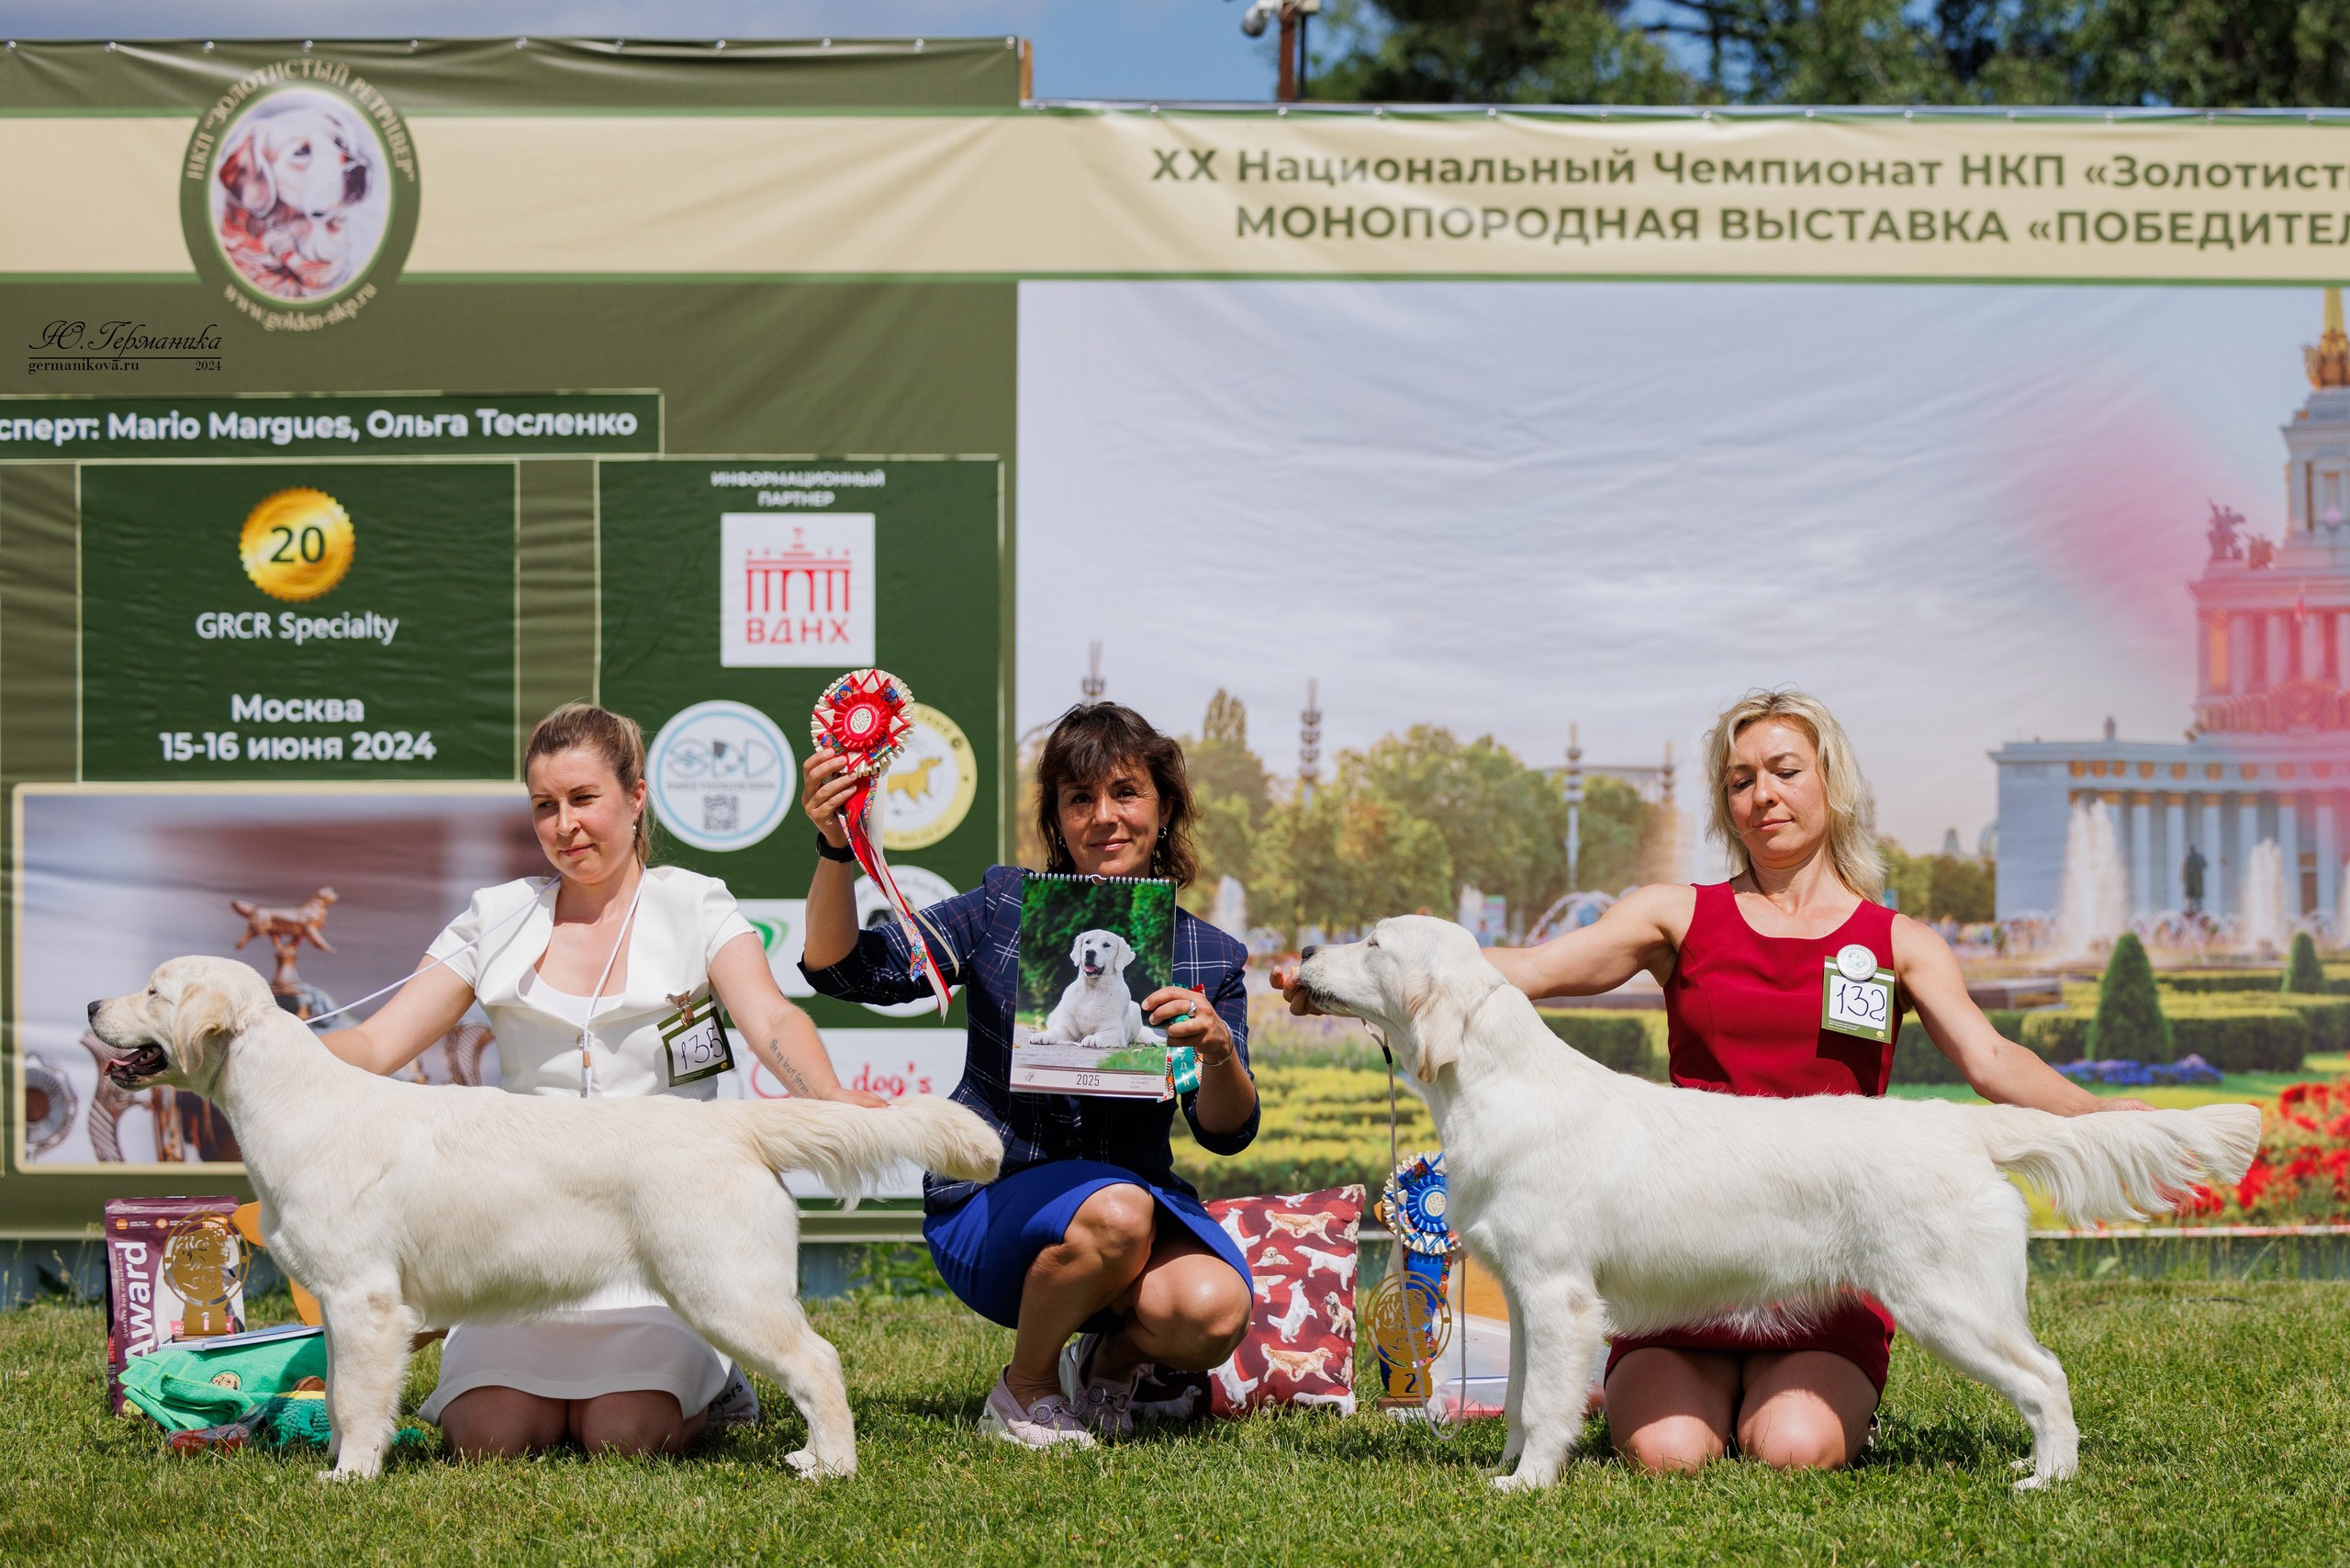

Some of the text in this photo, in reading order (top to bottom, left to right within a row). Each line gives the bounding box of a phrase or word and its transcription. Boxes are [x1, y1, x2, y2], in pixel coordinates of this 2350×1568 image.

[185, 131, 216, 181] НКП
[1237, 148, 1637, 186] Национальный
[1652, 151, 1942, 188] Чемпионат
[1960, 153, 2065, 186] НКП
[2084, 154, 2350, 189] «Золотист
[1235, 205, 1701, 246] МОНОПОРОДНАЯ
[1718, 207, 2010, 244] ВЫСТАВКА
[0, 409, 639, 447] сперт: Mario Margues, Ольга Тесленко
[710, 469, 886, 489] ИНФОРМАЦИОННЫЙ
[756, 490, 835, 508] ПАРТНЕР
[269, 526, 327, 564] 20
[195, 610, 399, 646] GRCR Specialty
[746, 618, 852, 644] ВДНХ
[230, 693, 365, 723] Москва
[159, 731, 438, 762] 15-16 июня 2024
[1836, 983, 1886, 1022] 132
[680, 1025, 725, 1071] 135
[853, 1060, 934, 1098] dog's
[1076, 1073, 1101, 1088] 2025
[118, 1252, 127, 1292] CHAMPIONS
[114, 1241, 155, 1361] Award
[120, 1307, 129, 1338] QUALITY
[201, 1312, 210, 1332] 1
[1404, 1372, 1418, 1394] 2
